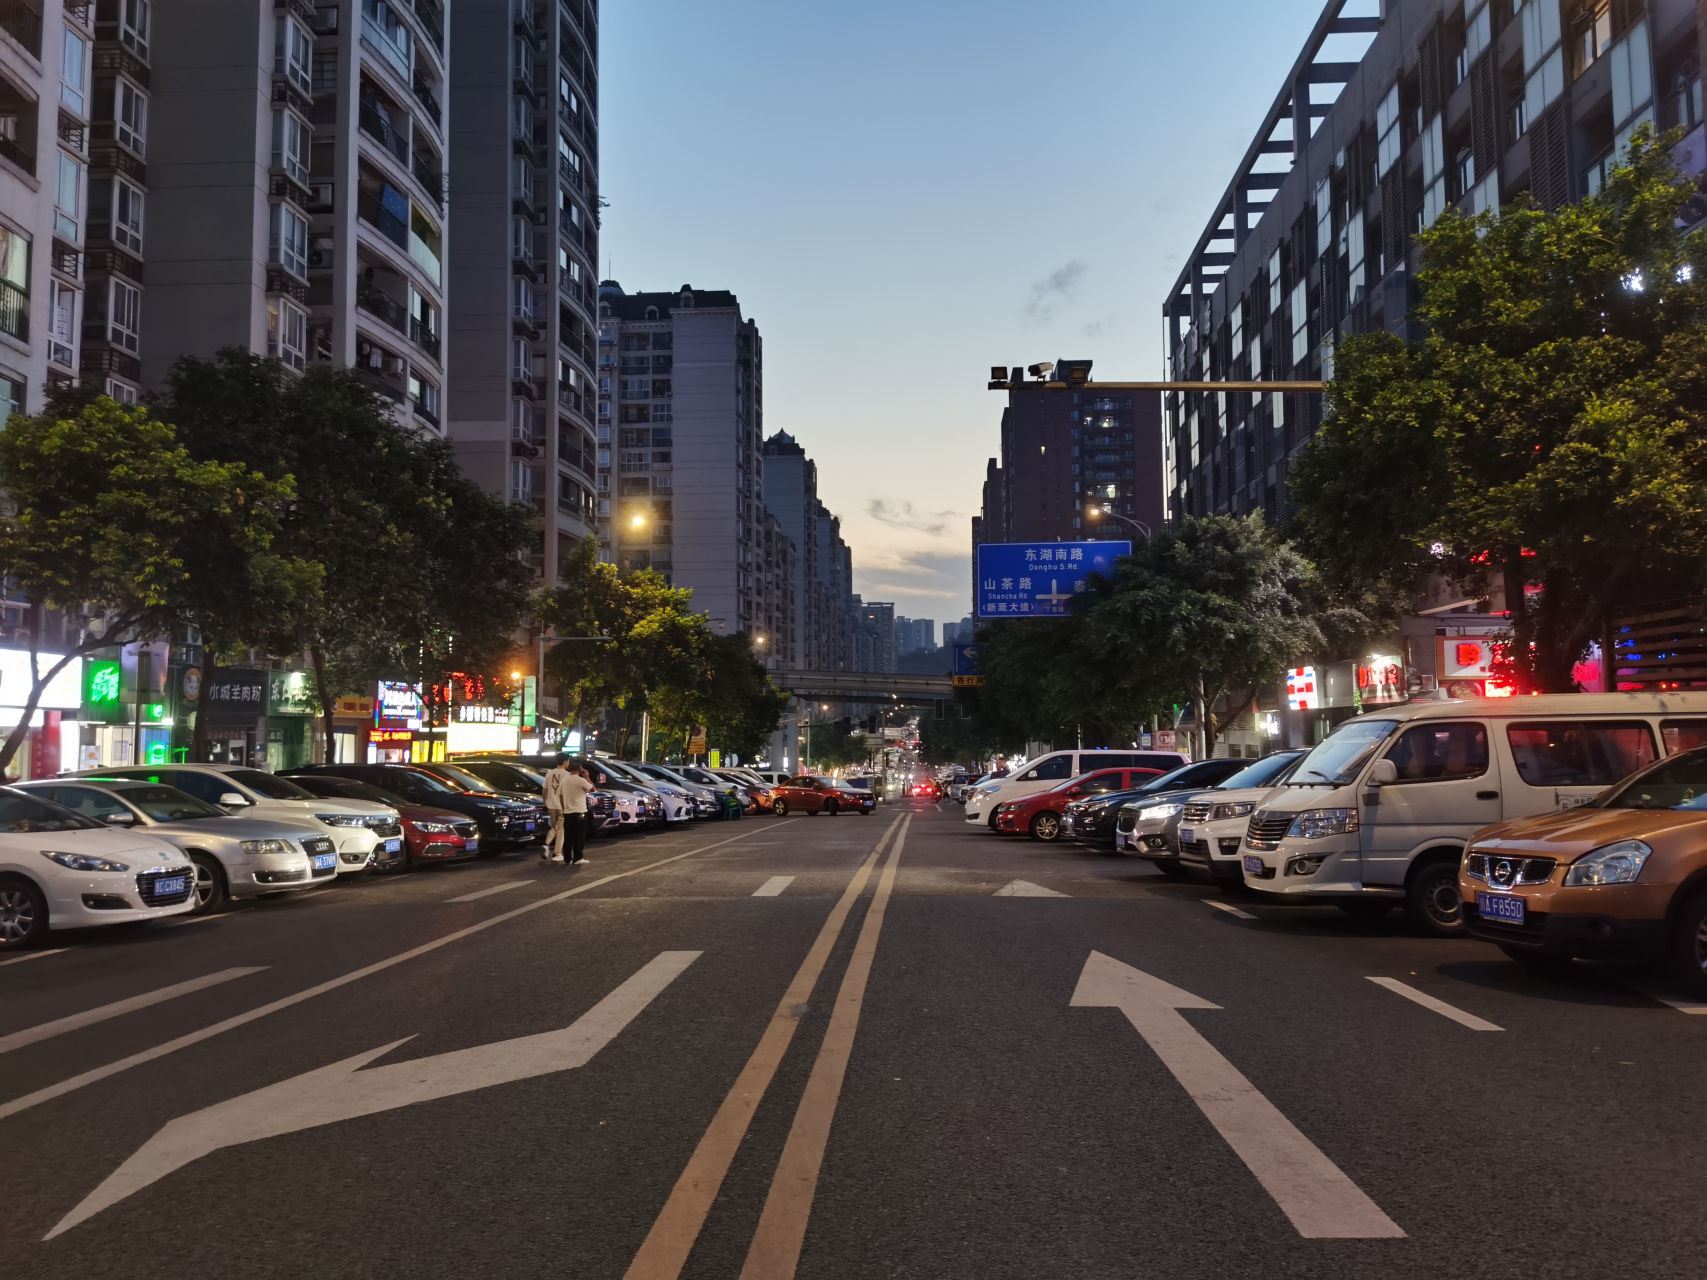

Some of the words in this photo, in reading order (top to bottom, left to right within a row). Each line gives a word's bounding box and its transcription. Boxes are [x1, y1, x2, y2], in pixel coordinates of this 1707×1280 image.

[1025, 548, 1083, 561] 东湖南路
[1029, 564, 1058, 572] Donghu
[984, 577, 1032, 590] 山茶路
